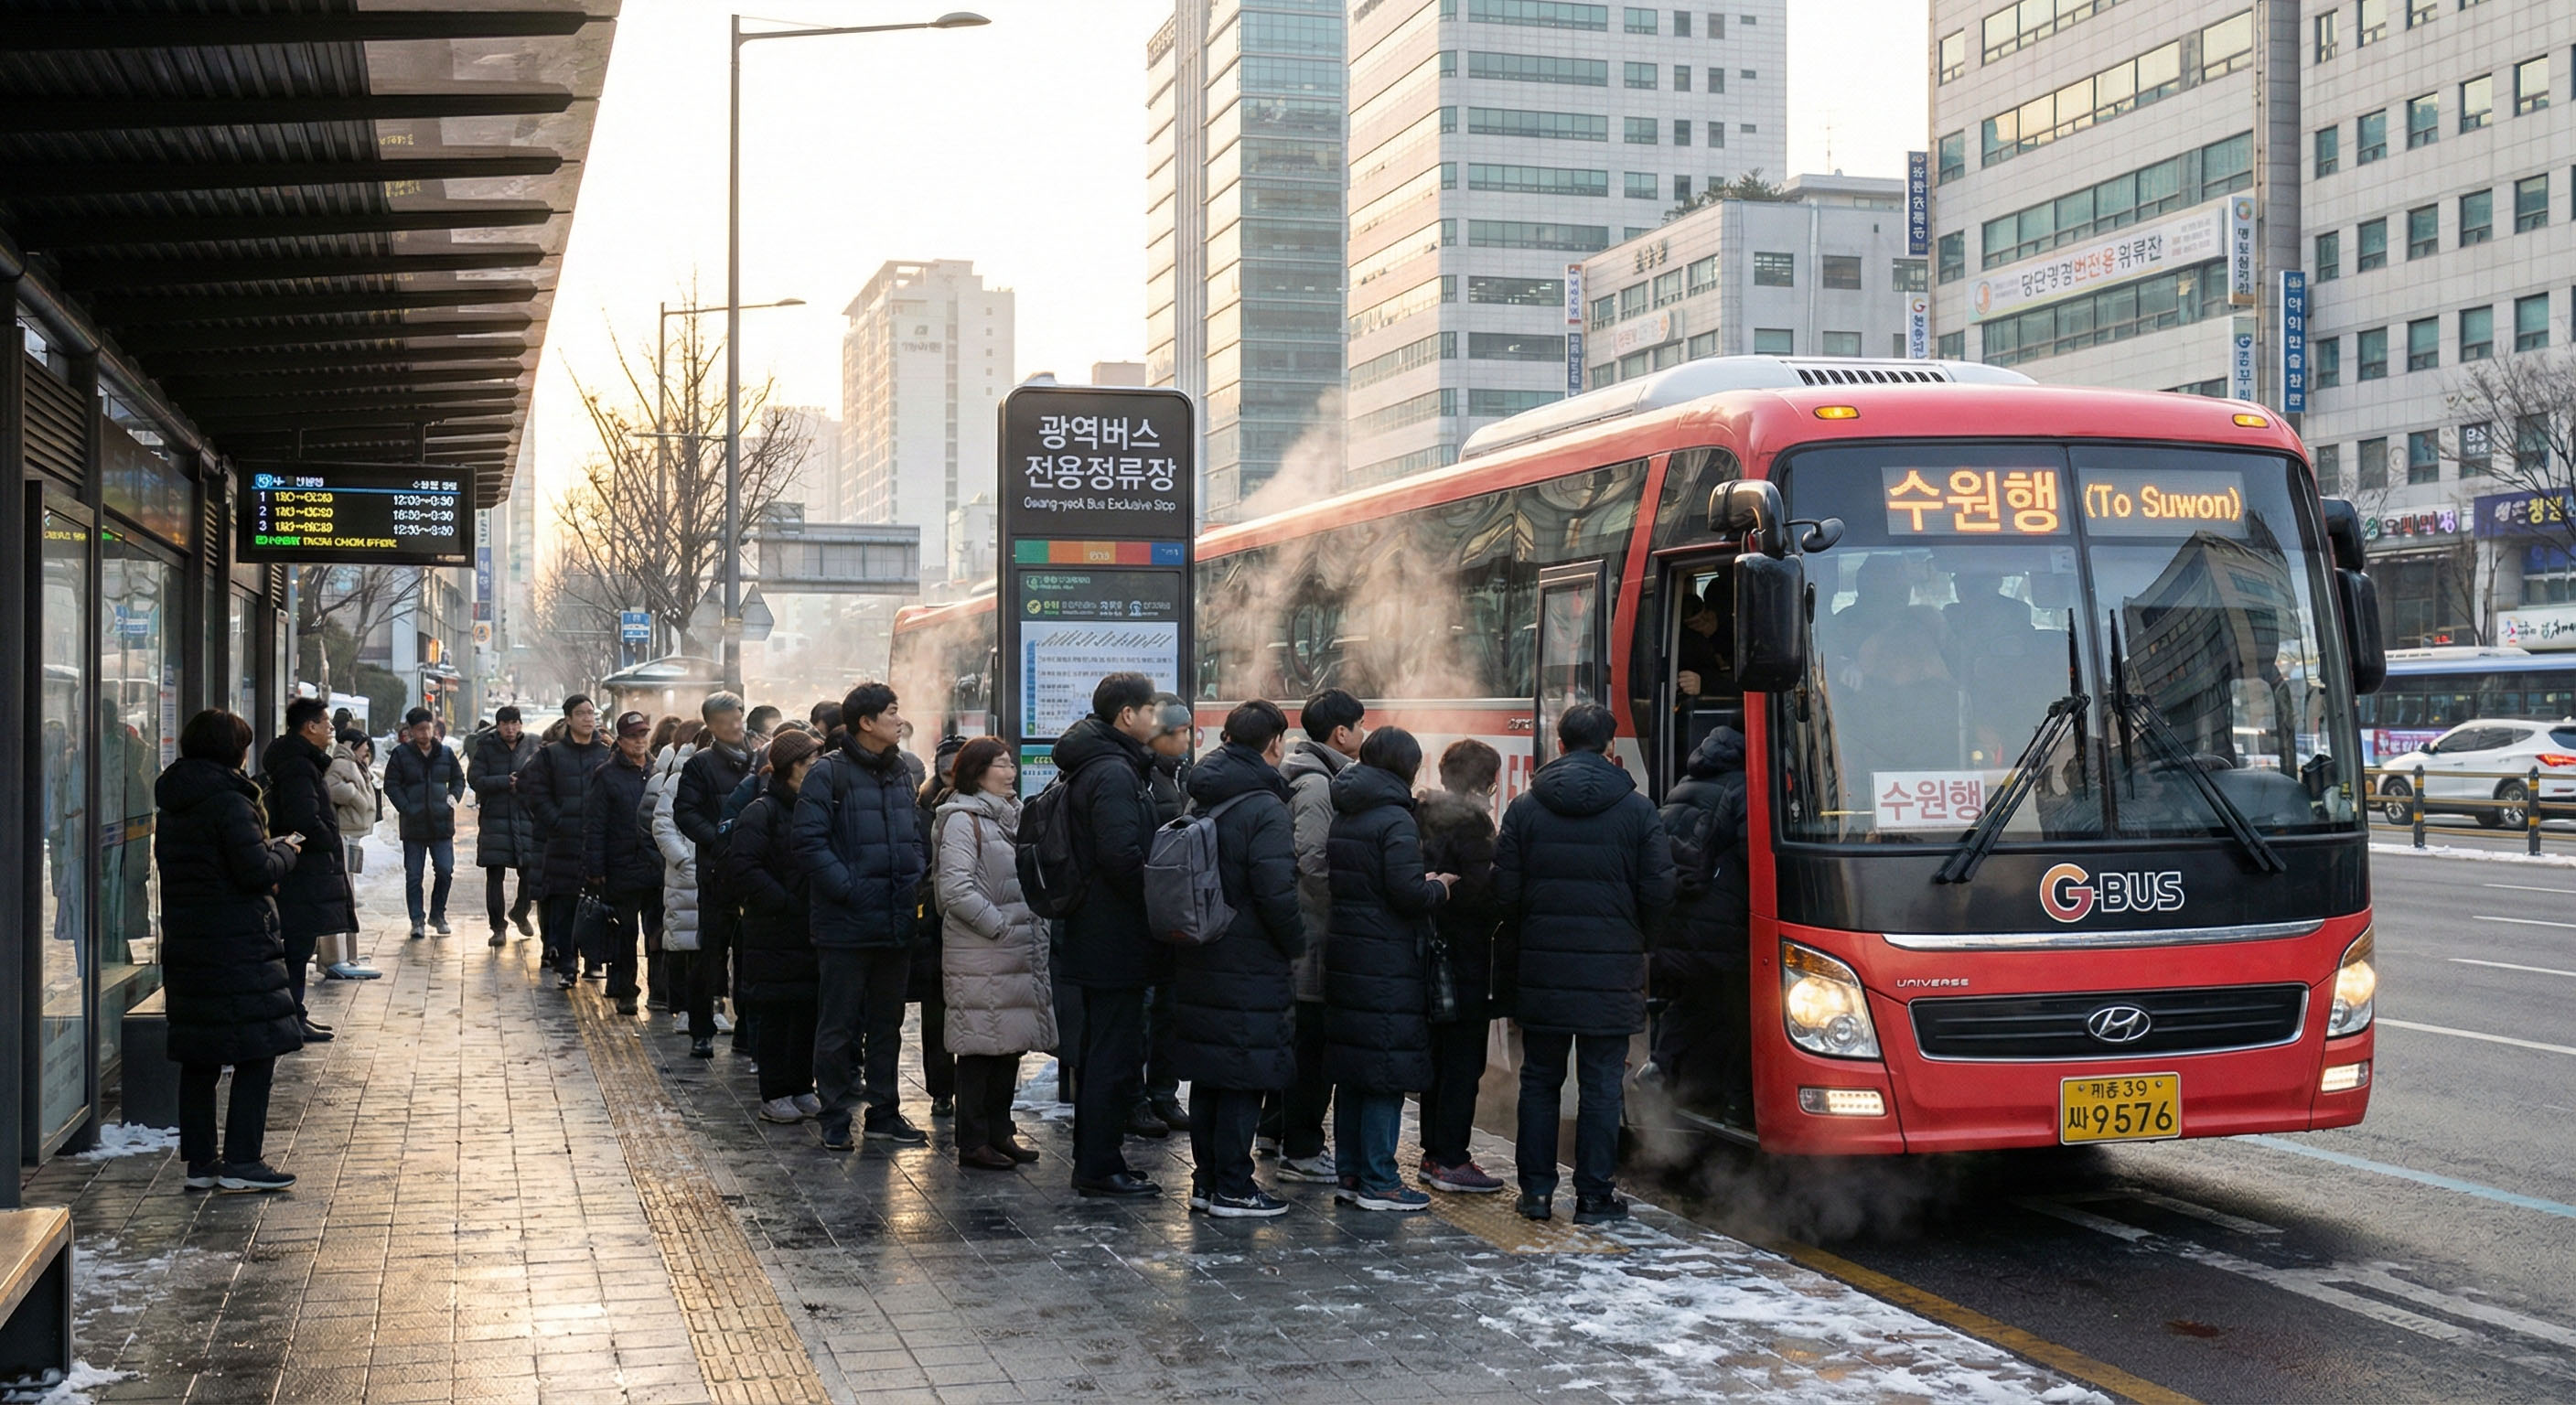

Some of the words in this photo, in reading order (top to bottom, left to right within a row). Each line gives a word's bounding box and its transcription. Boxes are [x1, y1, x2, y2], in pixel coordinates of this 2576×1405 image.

[1038, 415, 1160, 451] 광역버스
[1025, 455, 1177, 491] 전용정류장
[260, 491, 266, 502] 1
[1888, 469, 2059, 533] 수원행
[2085, 484, 2132, 520] (To
[2141, 486, 2241, 521] Suwon)
[259, 506, 267, 517] 2
[259, 520, 267, 531] 3
[1880, 778, 1983, 821] 수원행
[1896, 978, 1969, 988] UNIVERSE
[2122, 1080, 2147, 1098] 39
